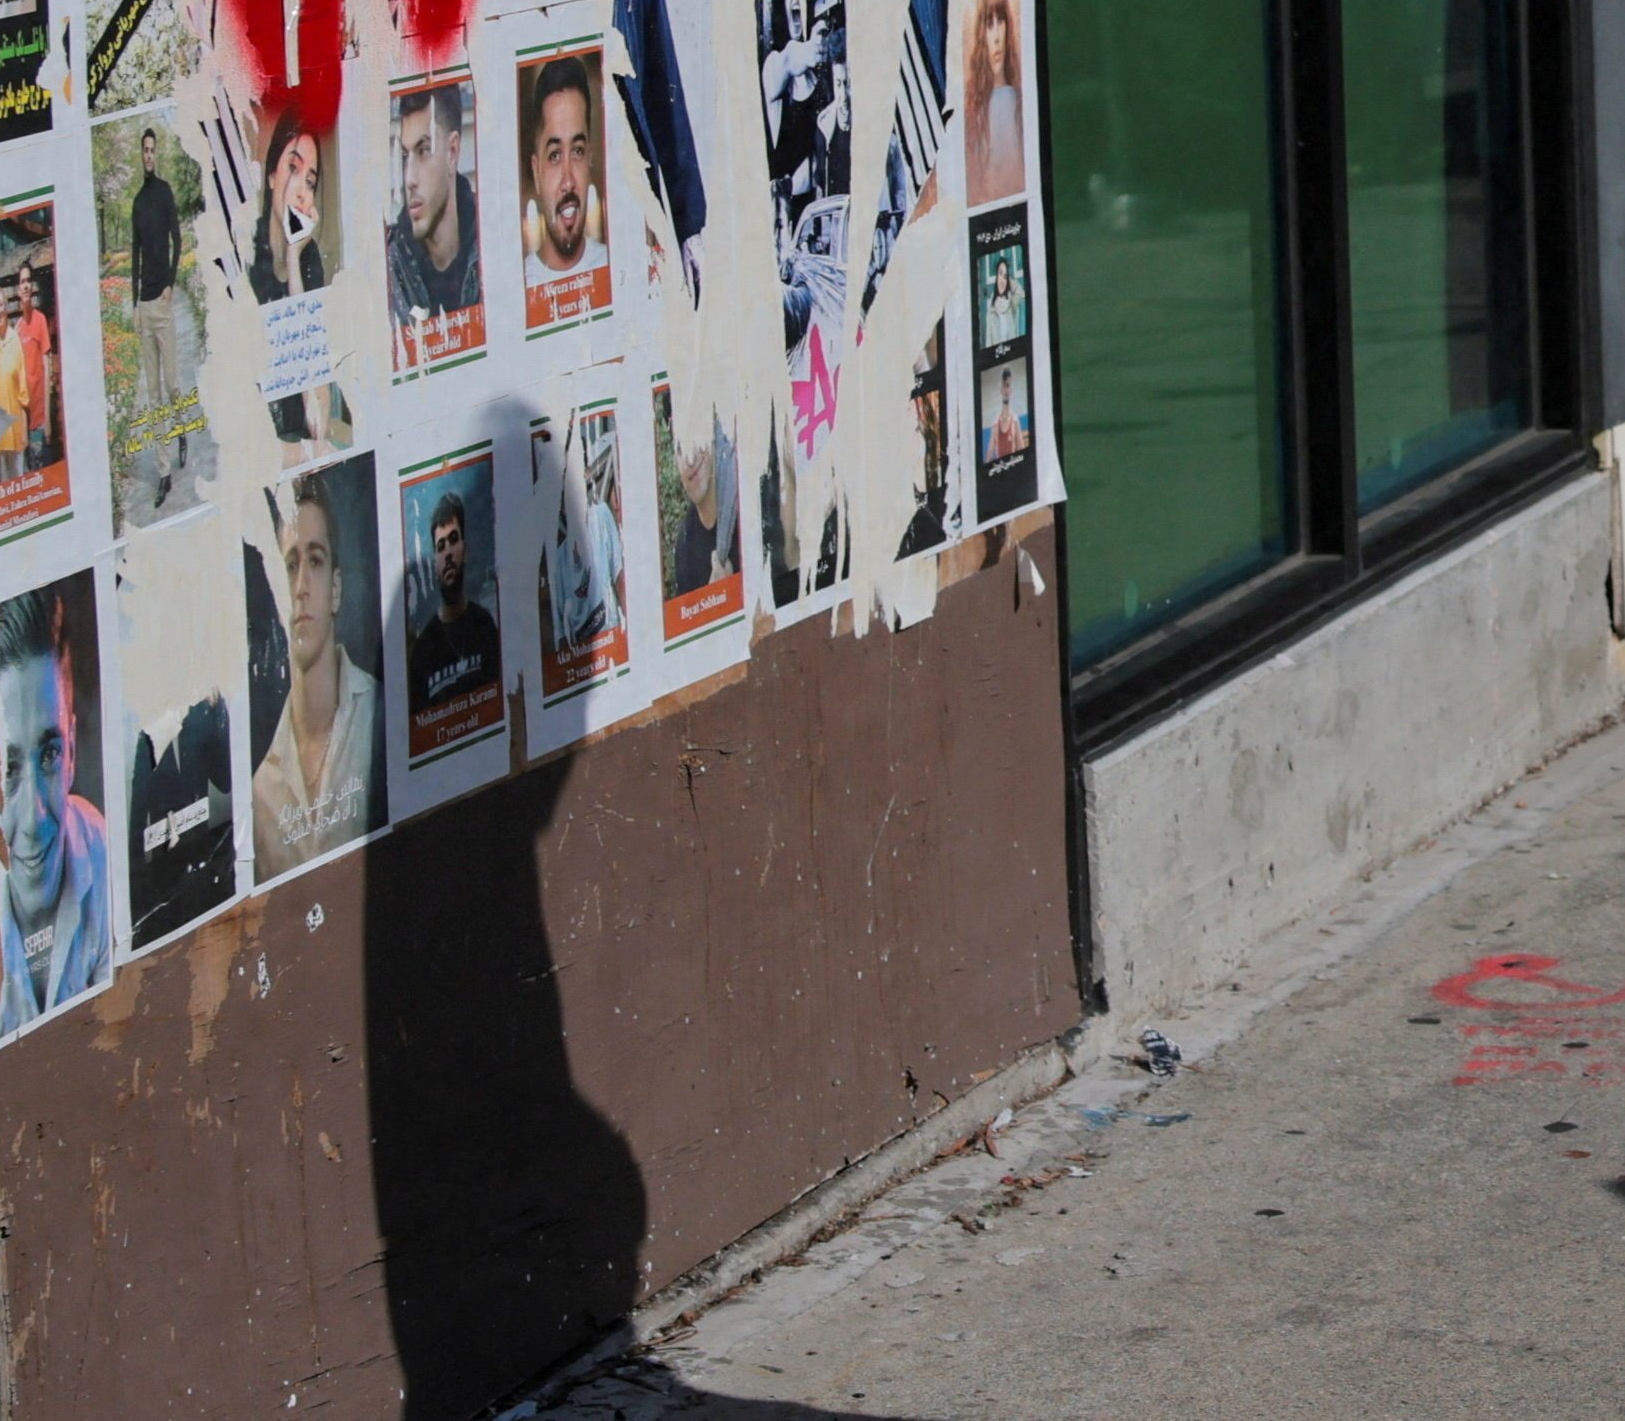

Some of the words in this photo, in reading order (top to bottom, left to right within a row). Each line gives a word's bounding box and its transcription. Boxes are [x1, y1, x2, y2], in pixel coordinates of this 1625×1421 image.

[21, 473, 44, 490] family
[700, 589, 727, 613] Sobhani
[575, 661, 596, 682] years
[468, 682, 498, 708] Karami
[445, 721, 467, 742] years
[24, 924, 54, 959] SEPEHR
